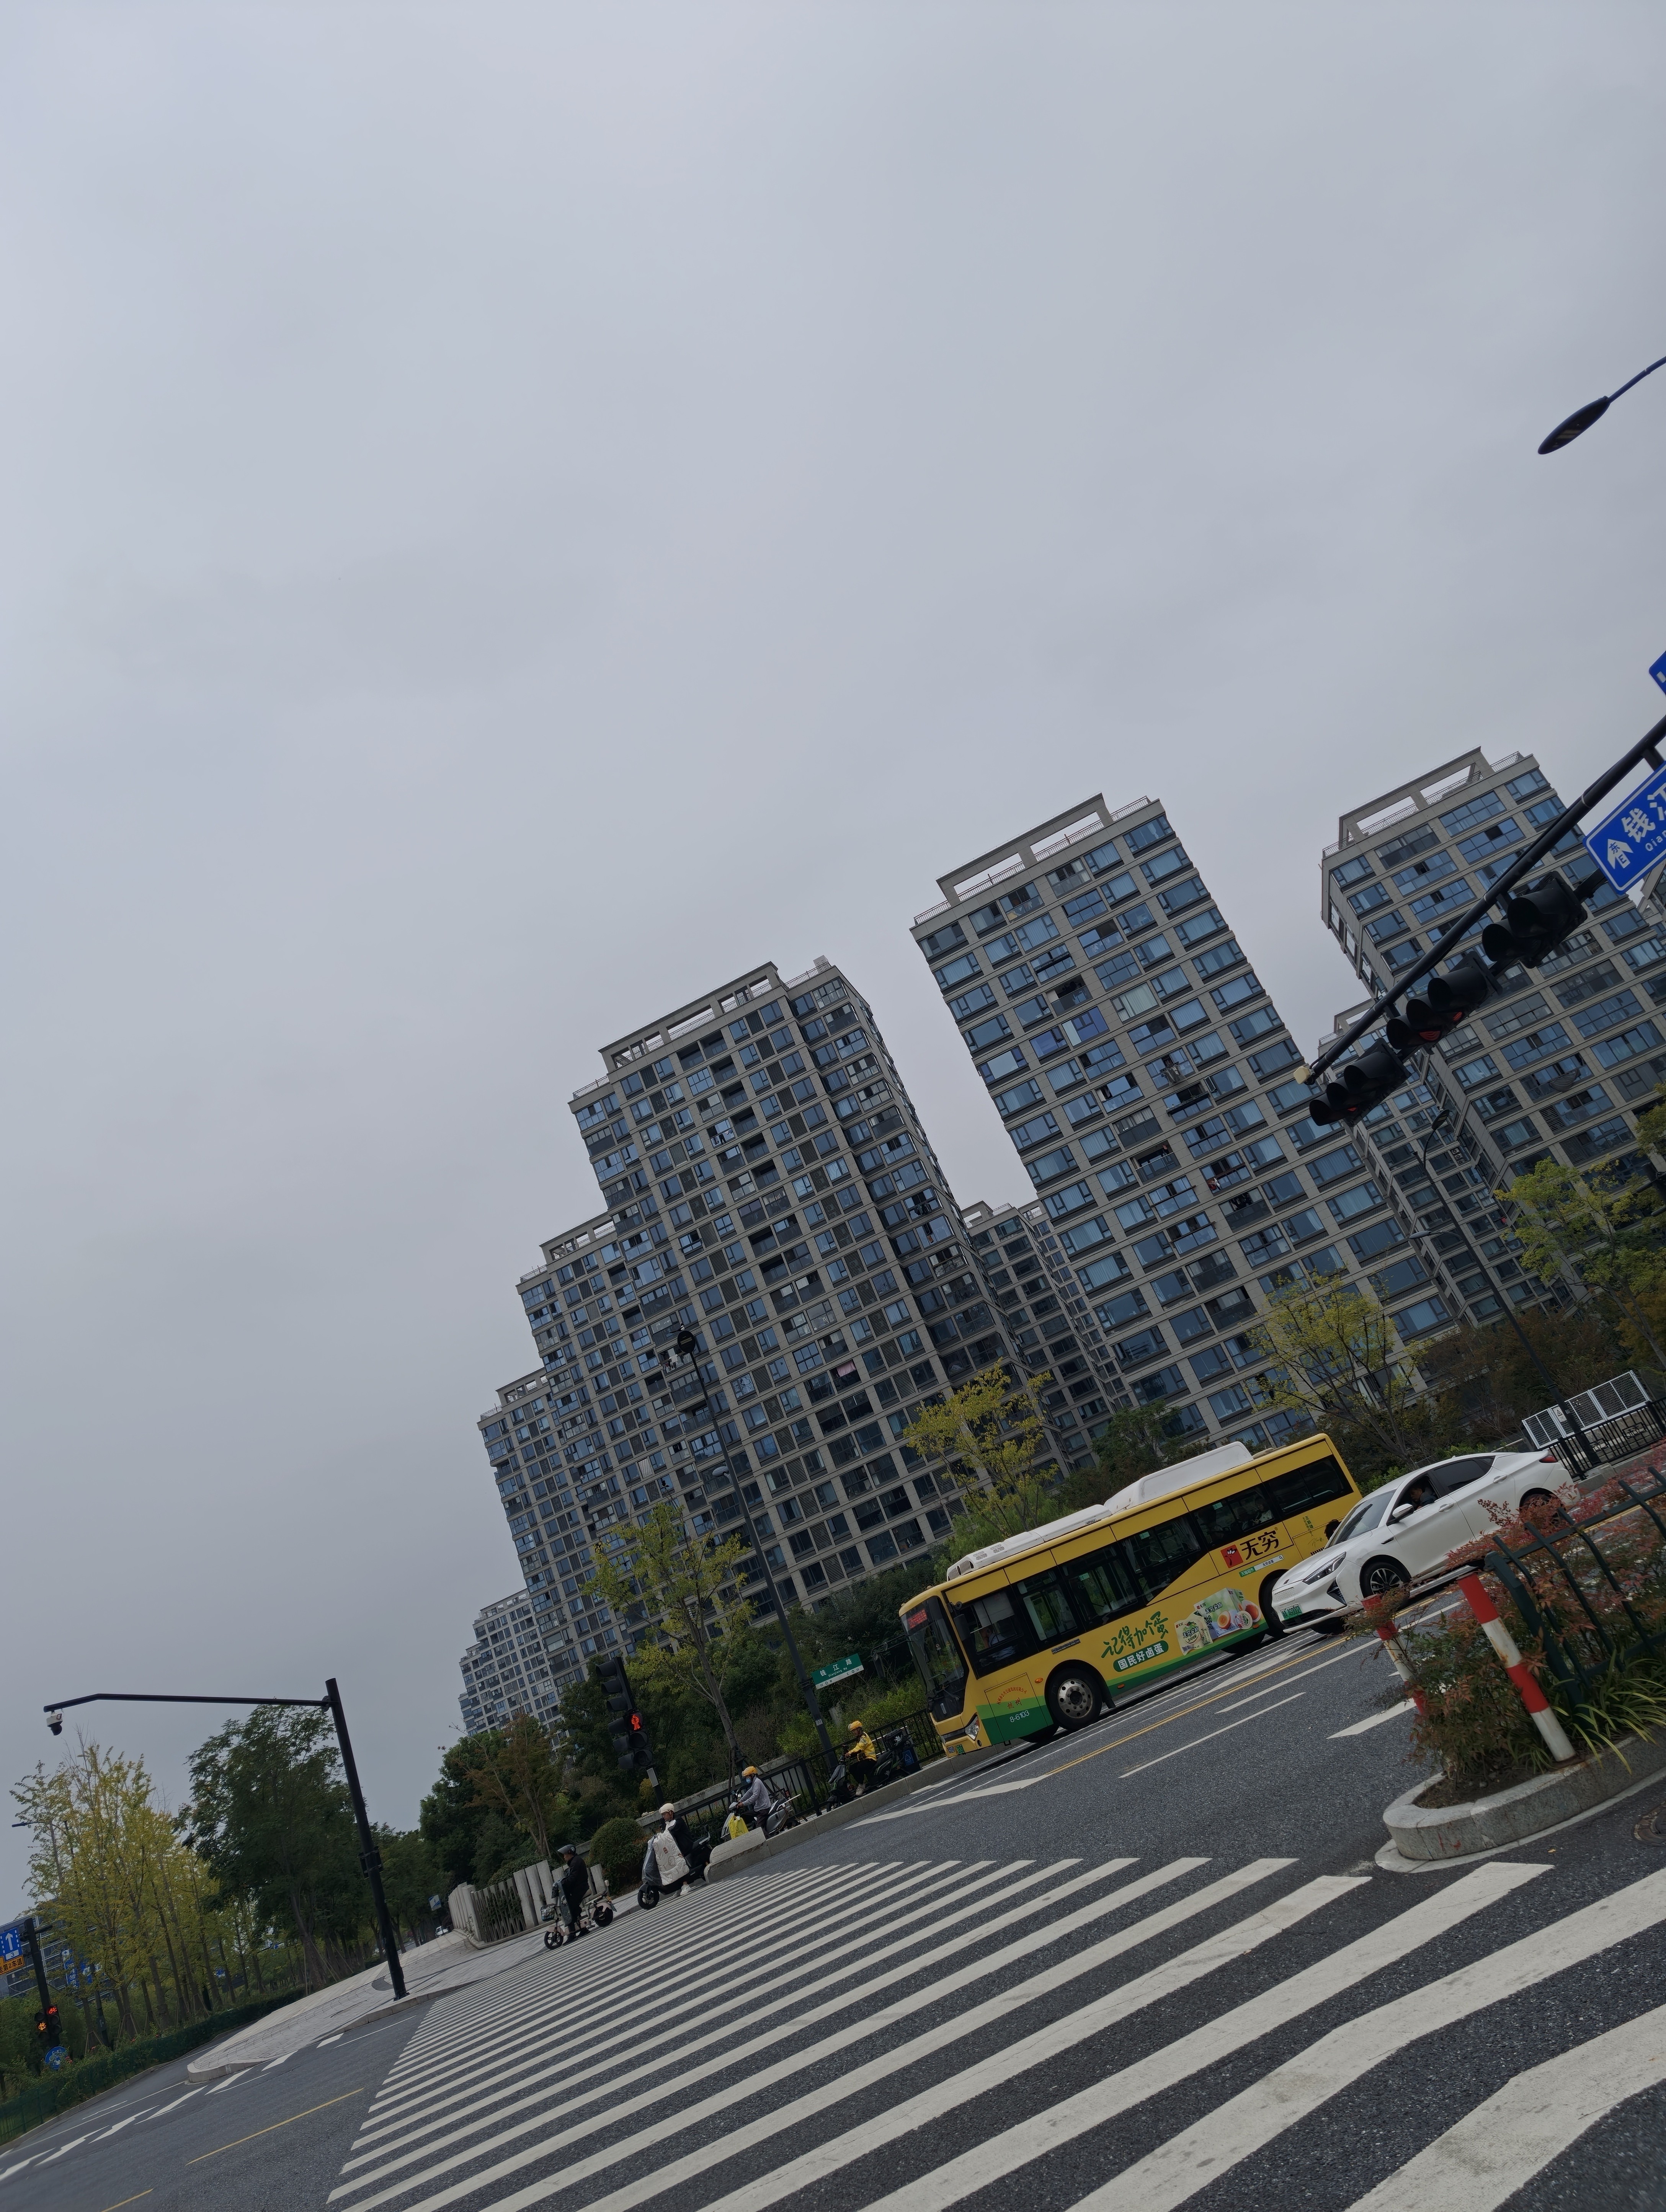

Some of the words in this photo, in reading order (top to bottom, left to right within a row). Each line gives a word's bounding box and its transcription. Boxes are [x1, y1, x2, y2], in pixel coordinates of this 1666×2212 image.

[1609, 842, 1620, 854] 东
[1618, 854, 1627, 864] E
[1240, 1530, 1279, 1560] 无穷
[1117, 1643, 1164, 1670] 国民好卤蛋
[820, 1659, 852, 1676] 钱江路
[1009, 1710, 1029, 1722] 8-6103
